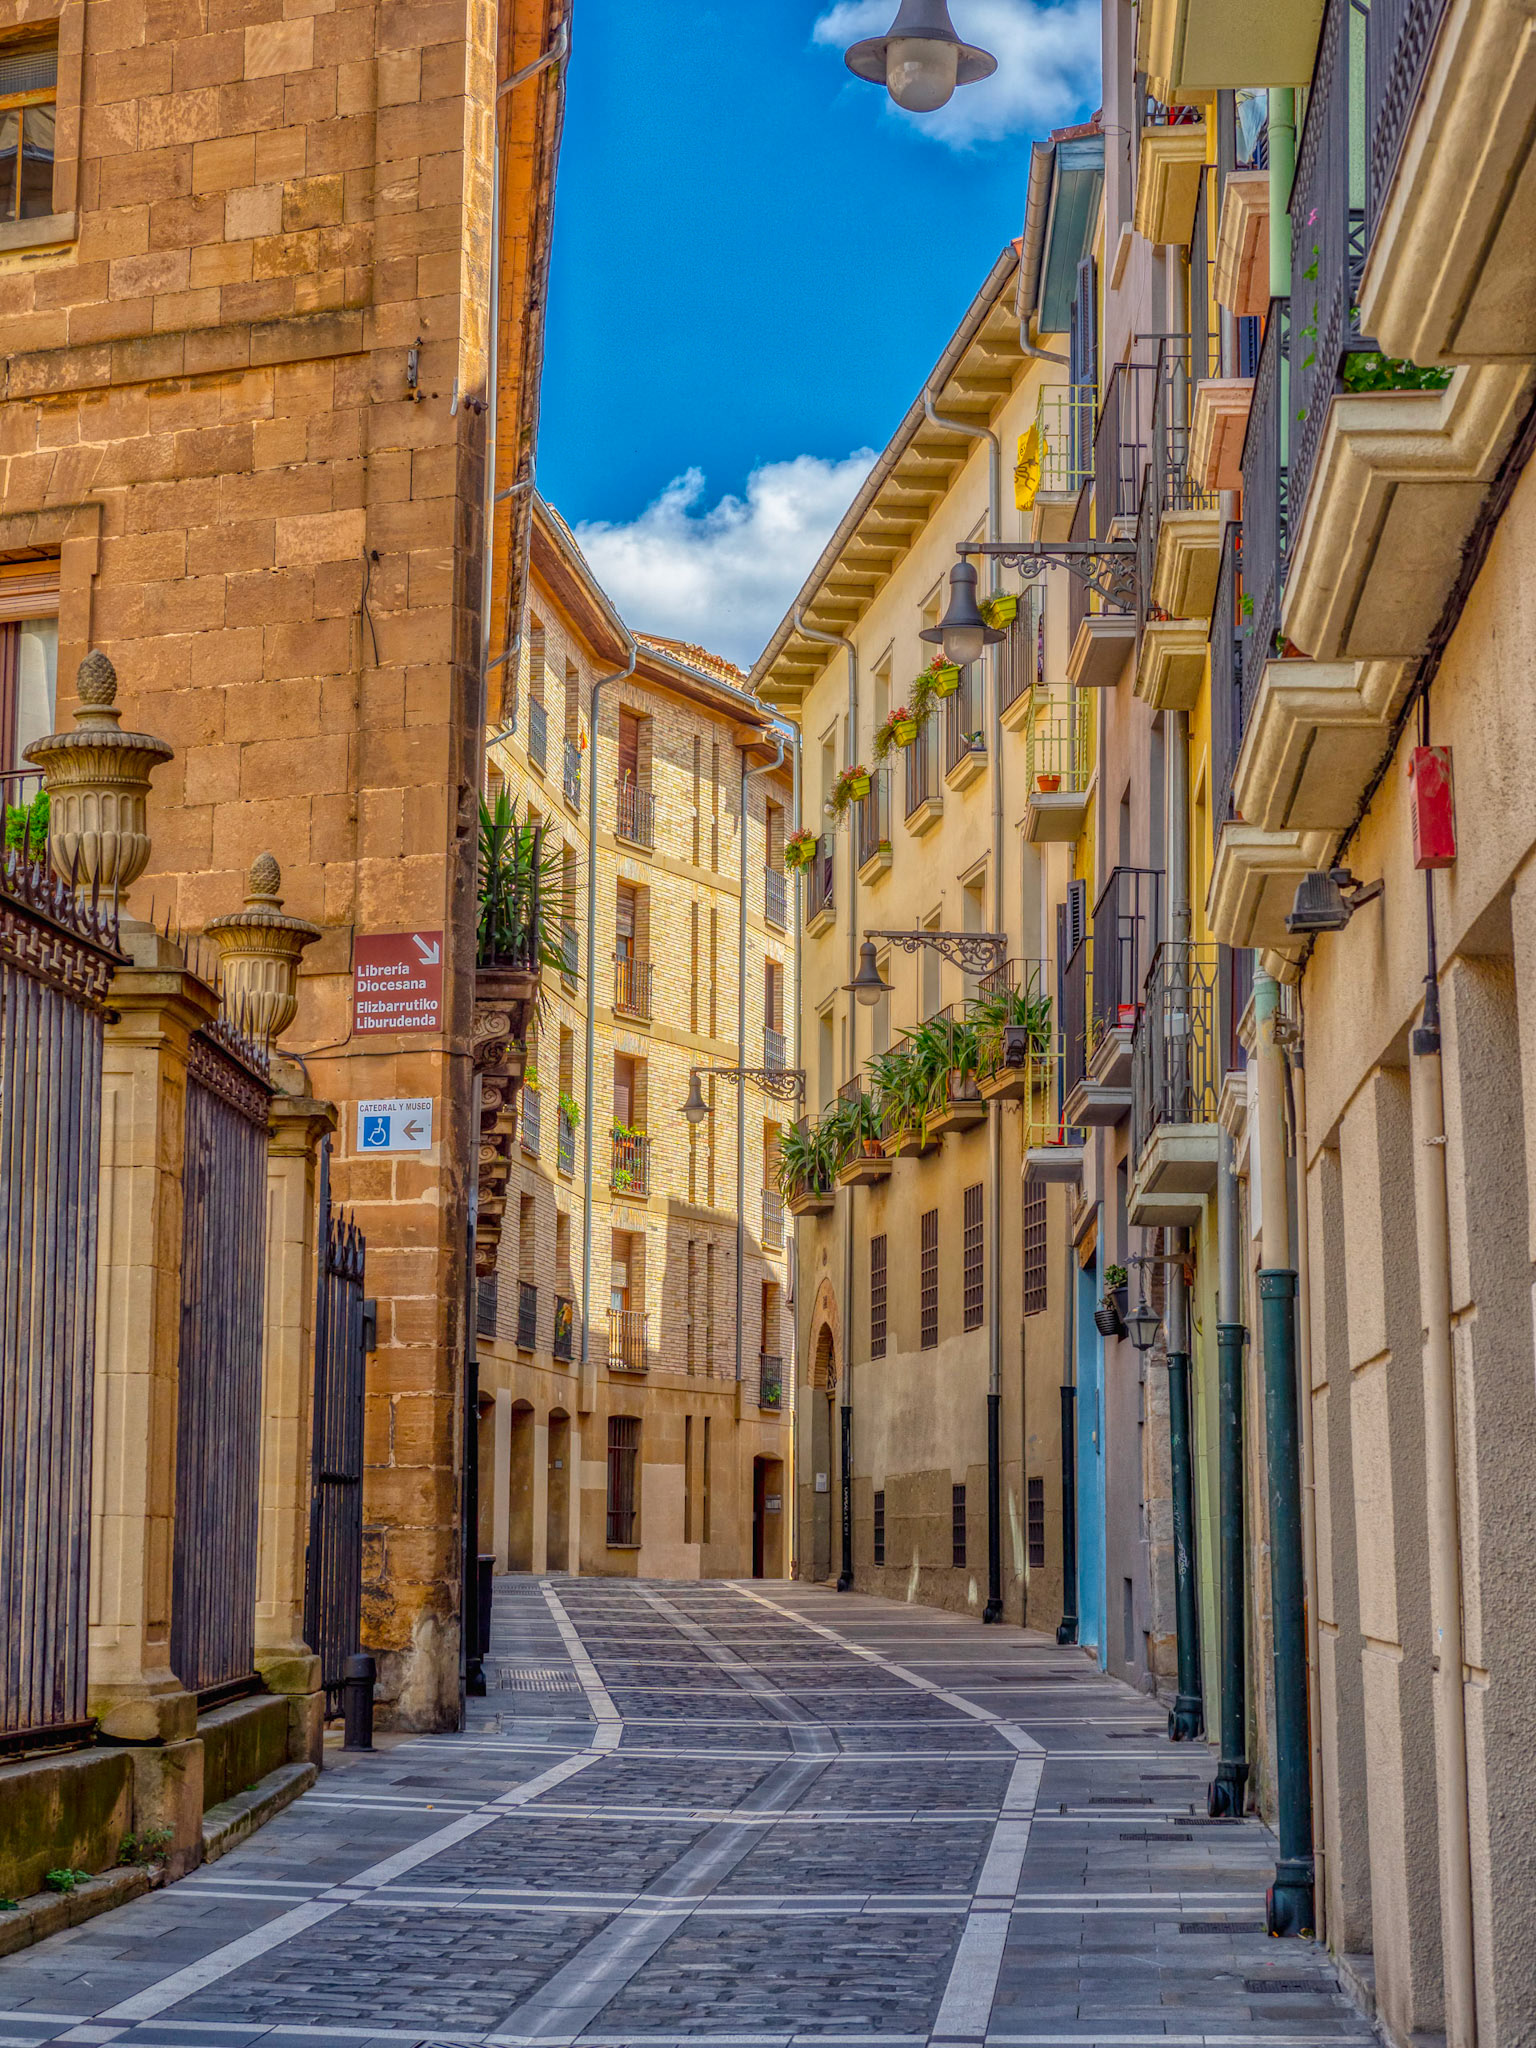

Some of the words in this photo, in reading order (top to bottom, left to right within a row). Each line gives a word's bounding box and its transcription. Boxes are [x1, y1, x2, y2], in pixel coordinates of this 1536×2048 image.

[357, 962, 410, 977] Librería
[357, 980, 427, 993] Diocesana
[356, 998, 438, 1013] Elizbarrutiko
[356, 1014, 436, 1029] Liburudenda
[359, 1103, 397, 1112] CATEDRAL
[399, 1103, 404, 1111] Y
[405, 1102, 431, 1110] MUSEO
